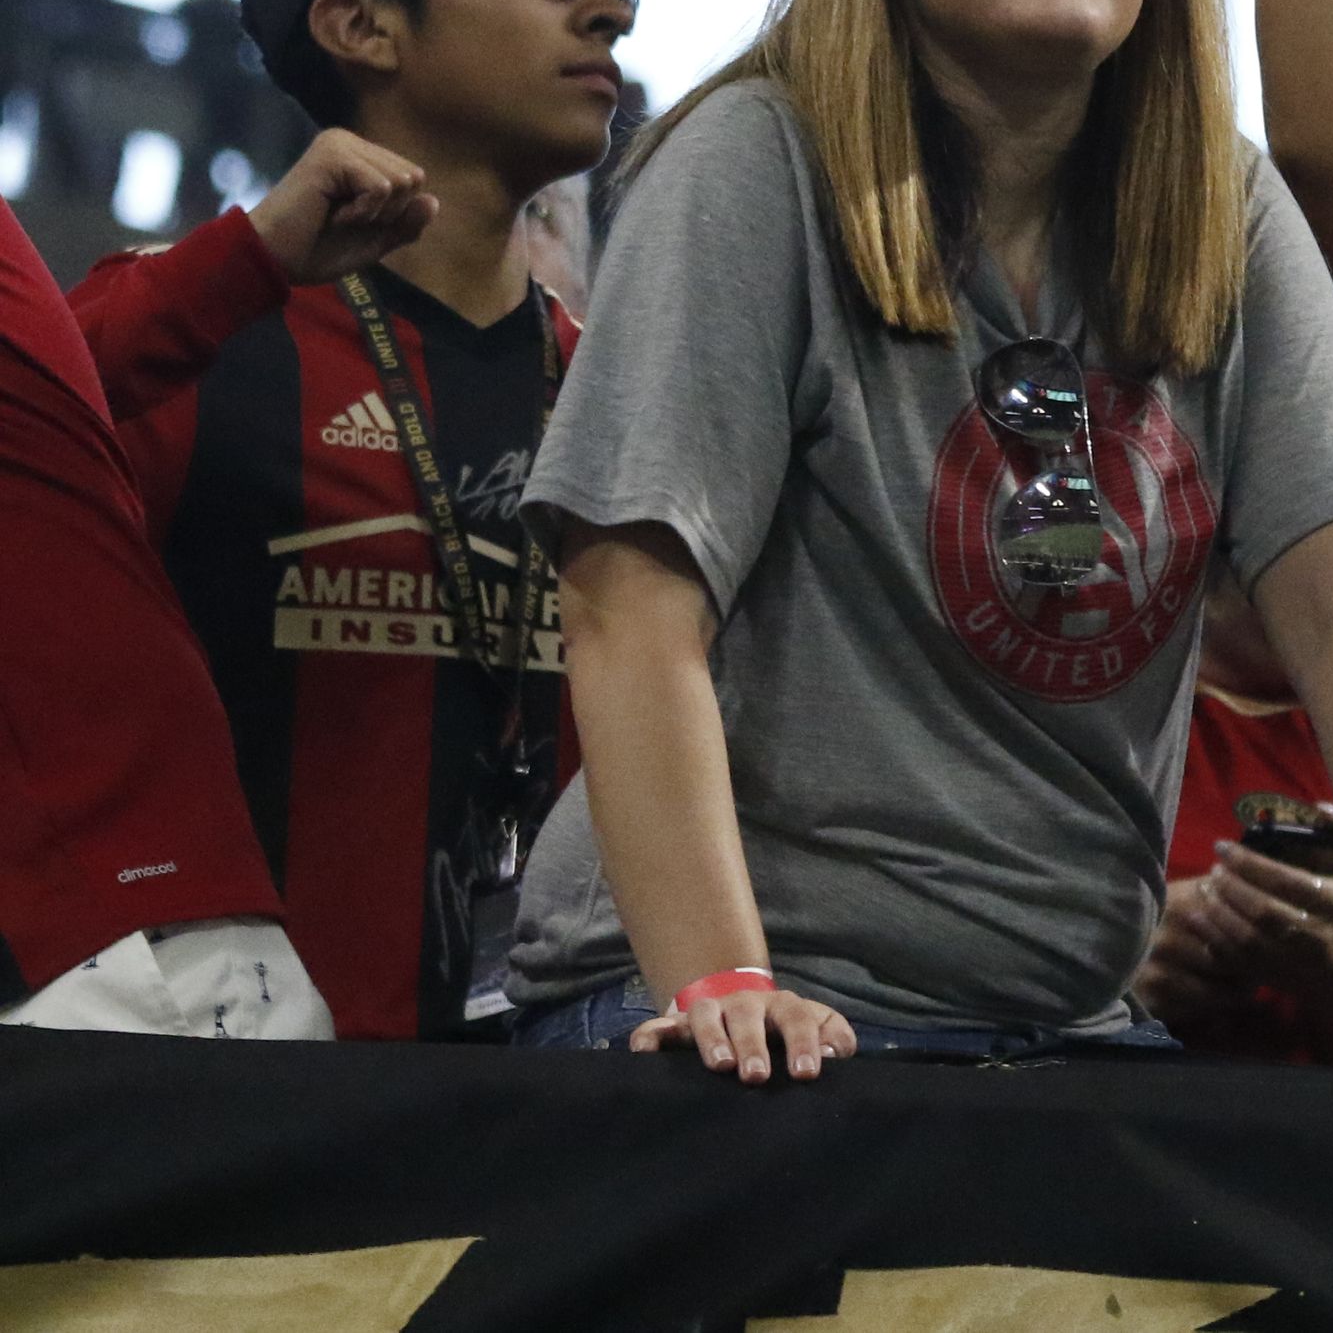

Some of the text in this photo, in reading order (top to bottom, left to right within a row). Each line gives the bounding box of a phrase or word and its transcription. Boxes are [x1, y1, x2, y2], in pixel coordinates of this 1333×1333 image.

[369, 323, 398, 369] UNITE
[321, 426, 403, 453] adida
[398, 401, 428, 447] BOLD
[415, 449, 442, 483] AND
[966, 584, 1182, 686] UNITED FC
